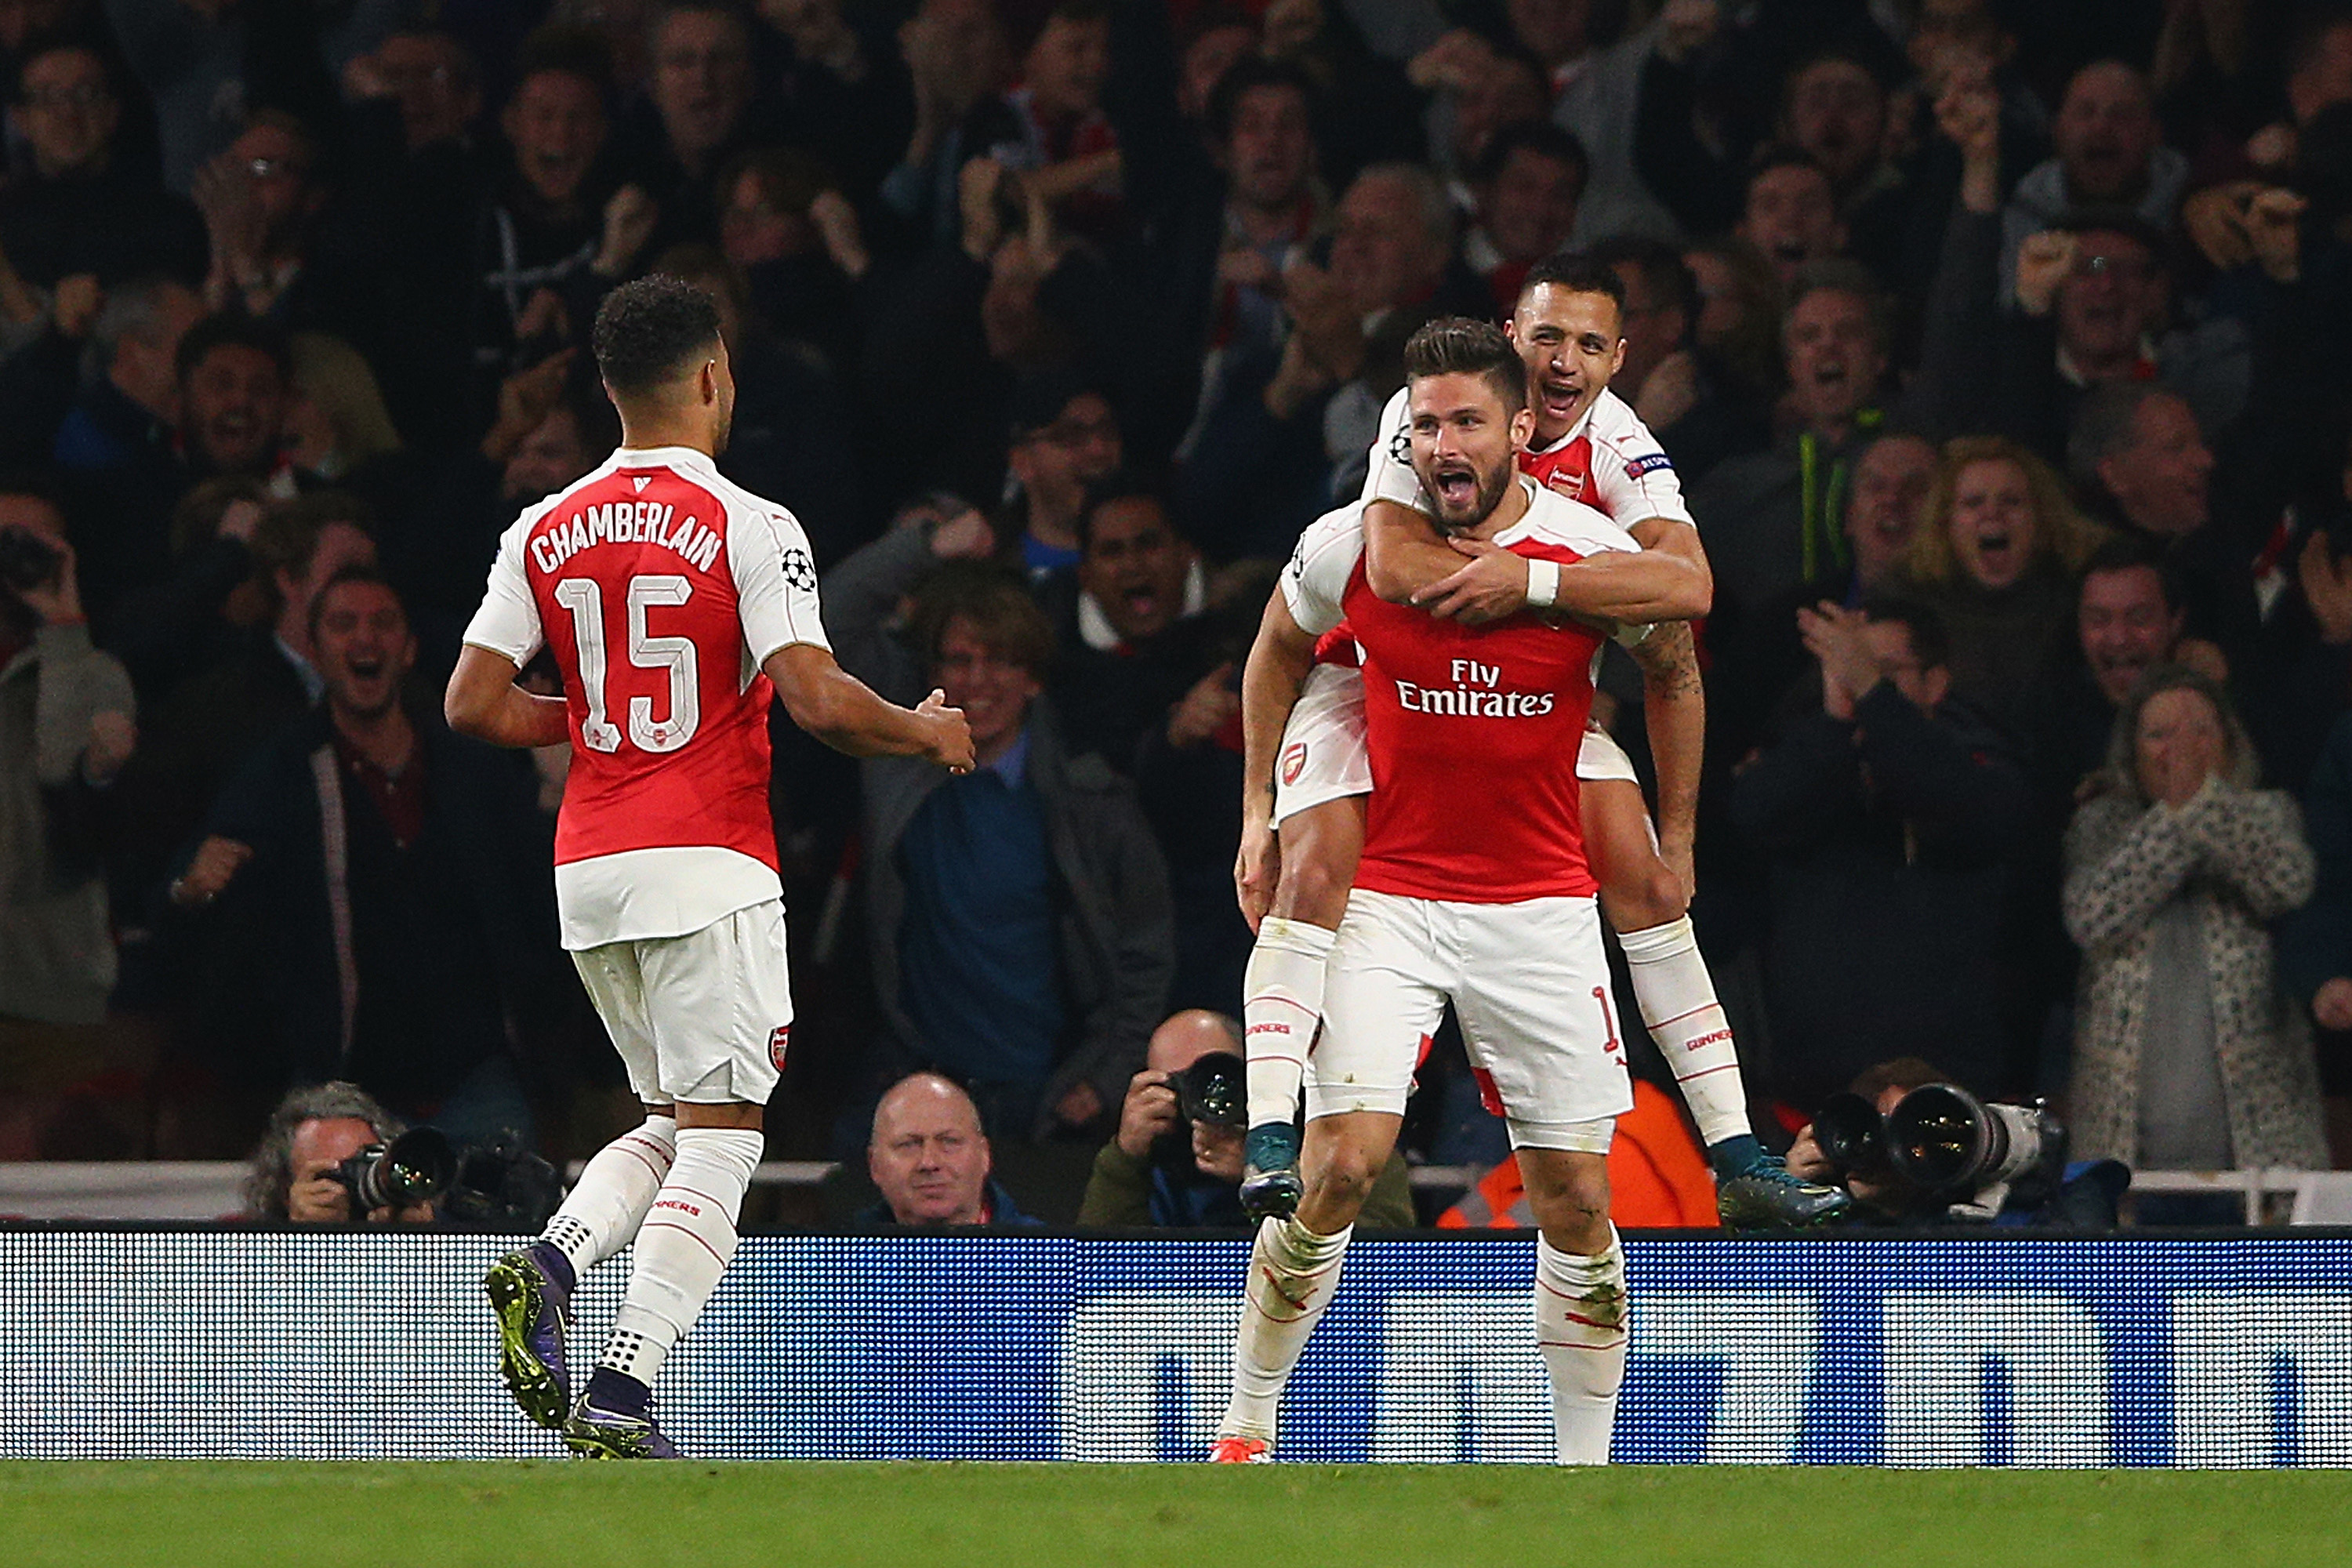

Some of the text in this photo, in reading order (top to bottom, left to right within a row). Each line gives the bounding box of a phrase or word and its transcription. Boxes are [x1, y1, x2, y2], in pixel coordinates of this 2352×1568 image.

[531, 502, 722, 574] CHAMBERLAIN
[554, 575, 701, 753] 15
[1451, 659, 1500, 688] Fly
[1395, 680, 1555, 717] Emirates
